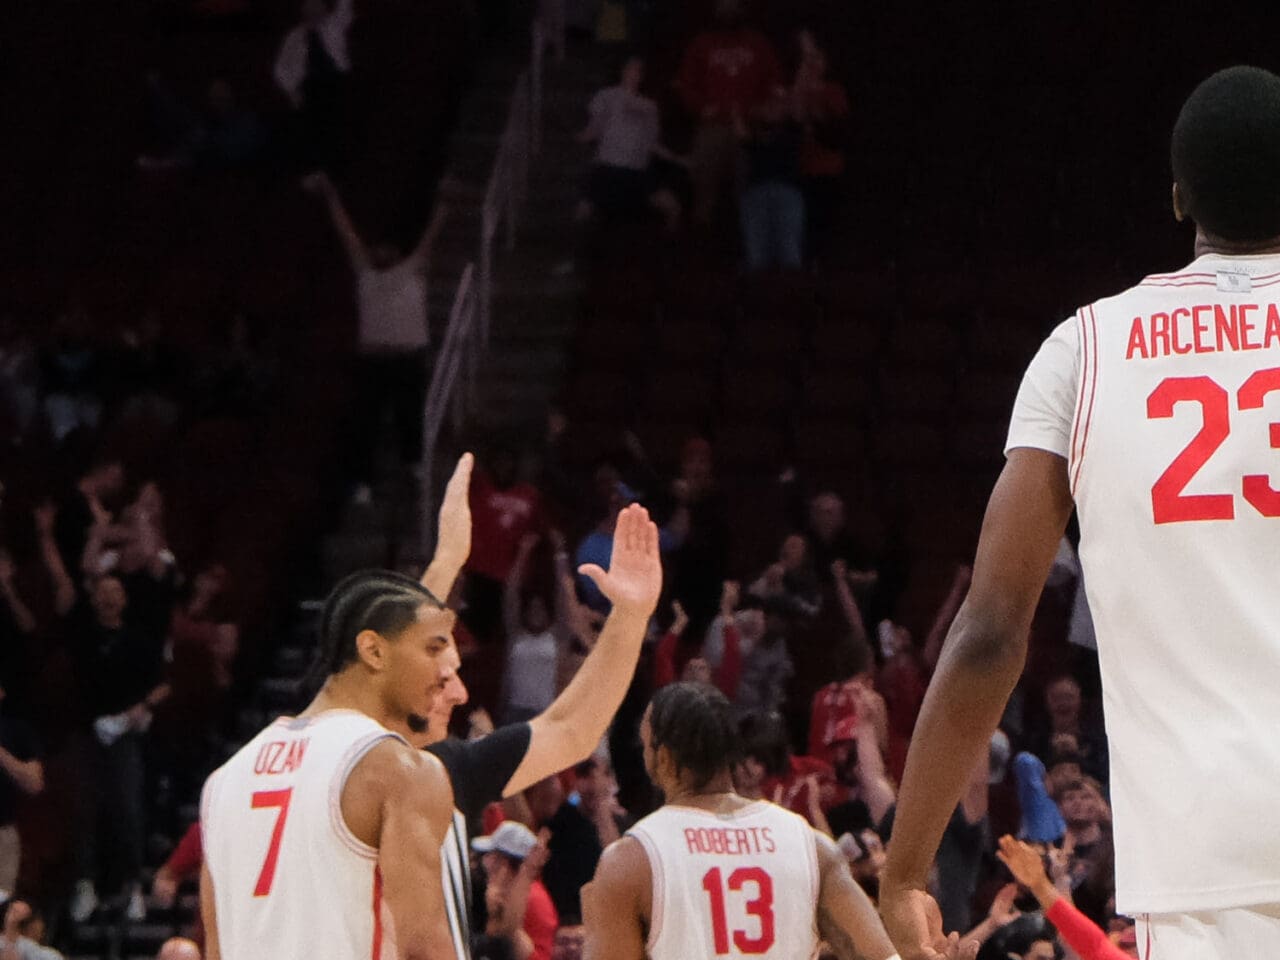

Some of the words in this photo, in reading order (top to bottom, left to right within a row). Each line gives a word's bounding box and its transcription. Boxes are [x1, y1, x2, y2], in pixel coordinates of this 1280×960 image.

[251, 786, 294, 898] 7
[684, 827, 776, 855] ROBERTS
[702, 866, 776, 955] 13
